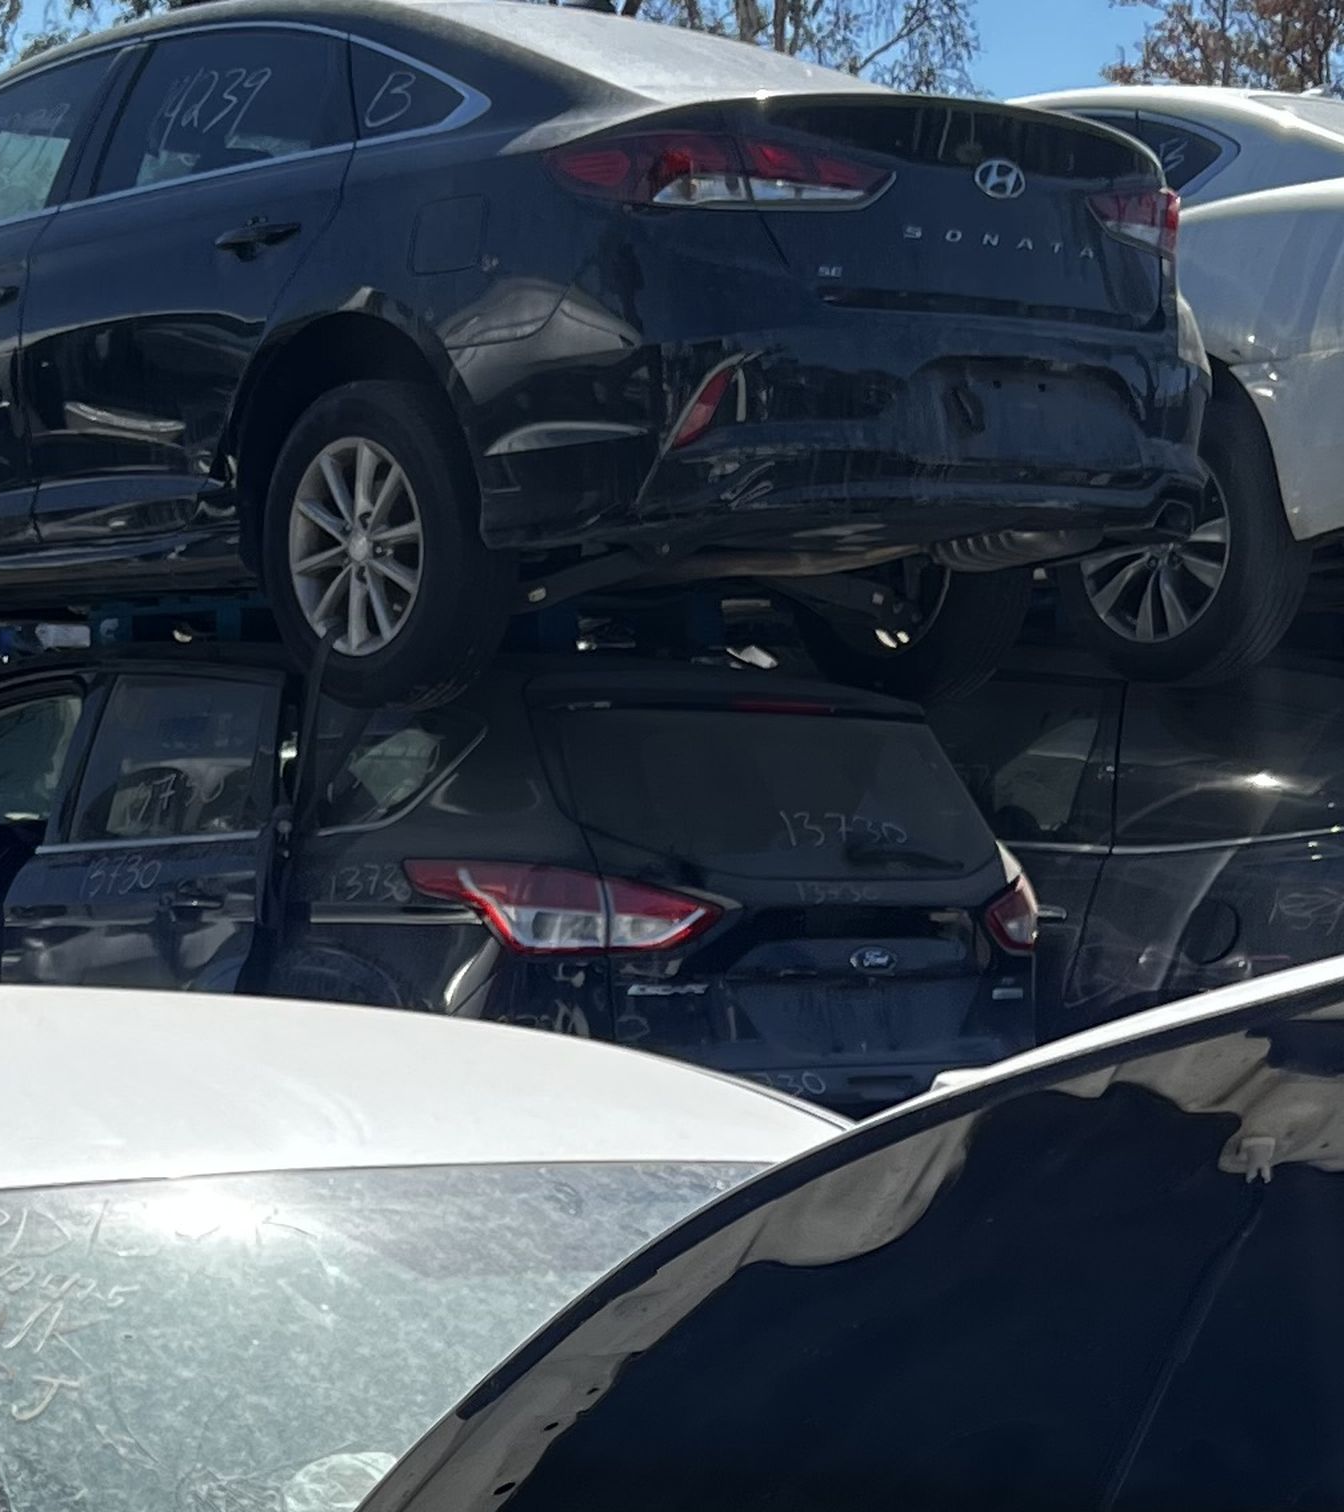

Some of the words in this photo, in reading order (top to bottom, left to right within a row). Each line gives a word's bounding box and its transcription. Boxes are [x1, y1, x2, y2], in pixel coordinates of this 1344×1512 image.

[365, 71, 416, 127] B
[901, 225, 1095, 260] SONATA
[779, 810, 907, 847] 13730
